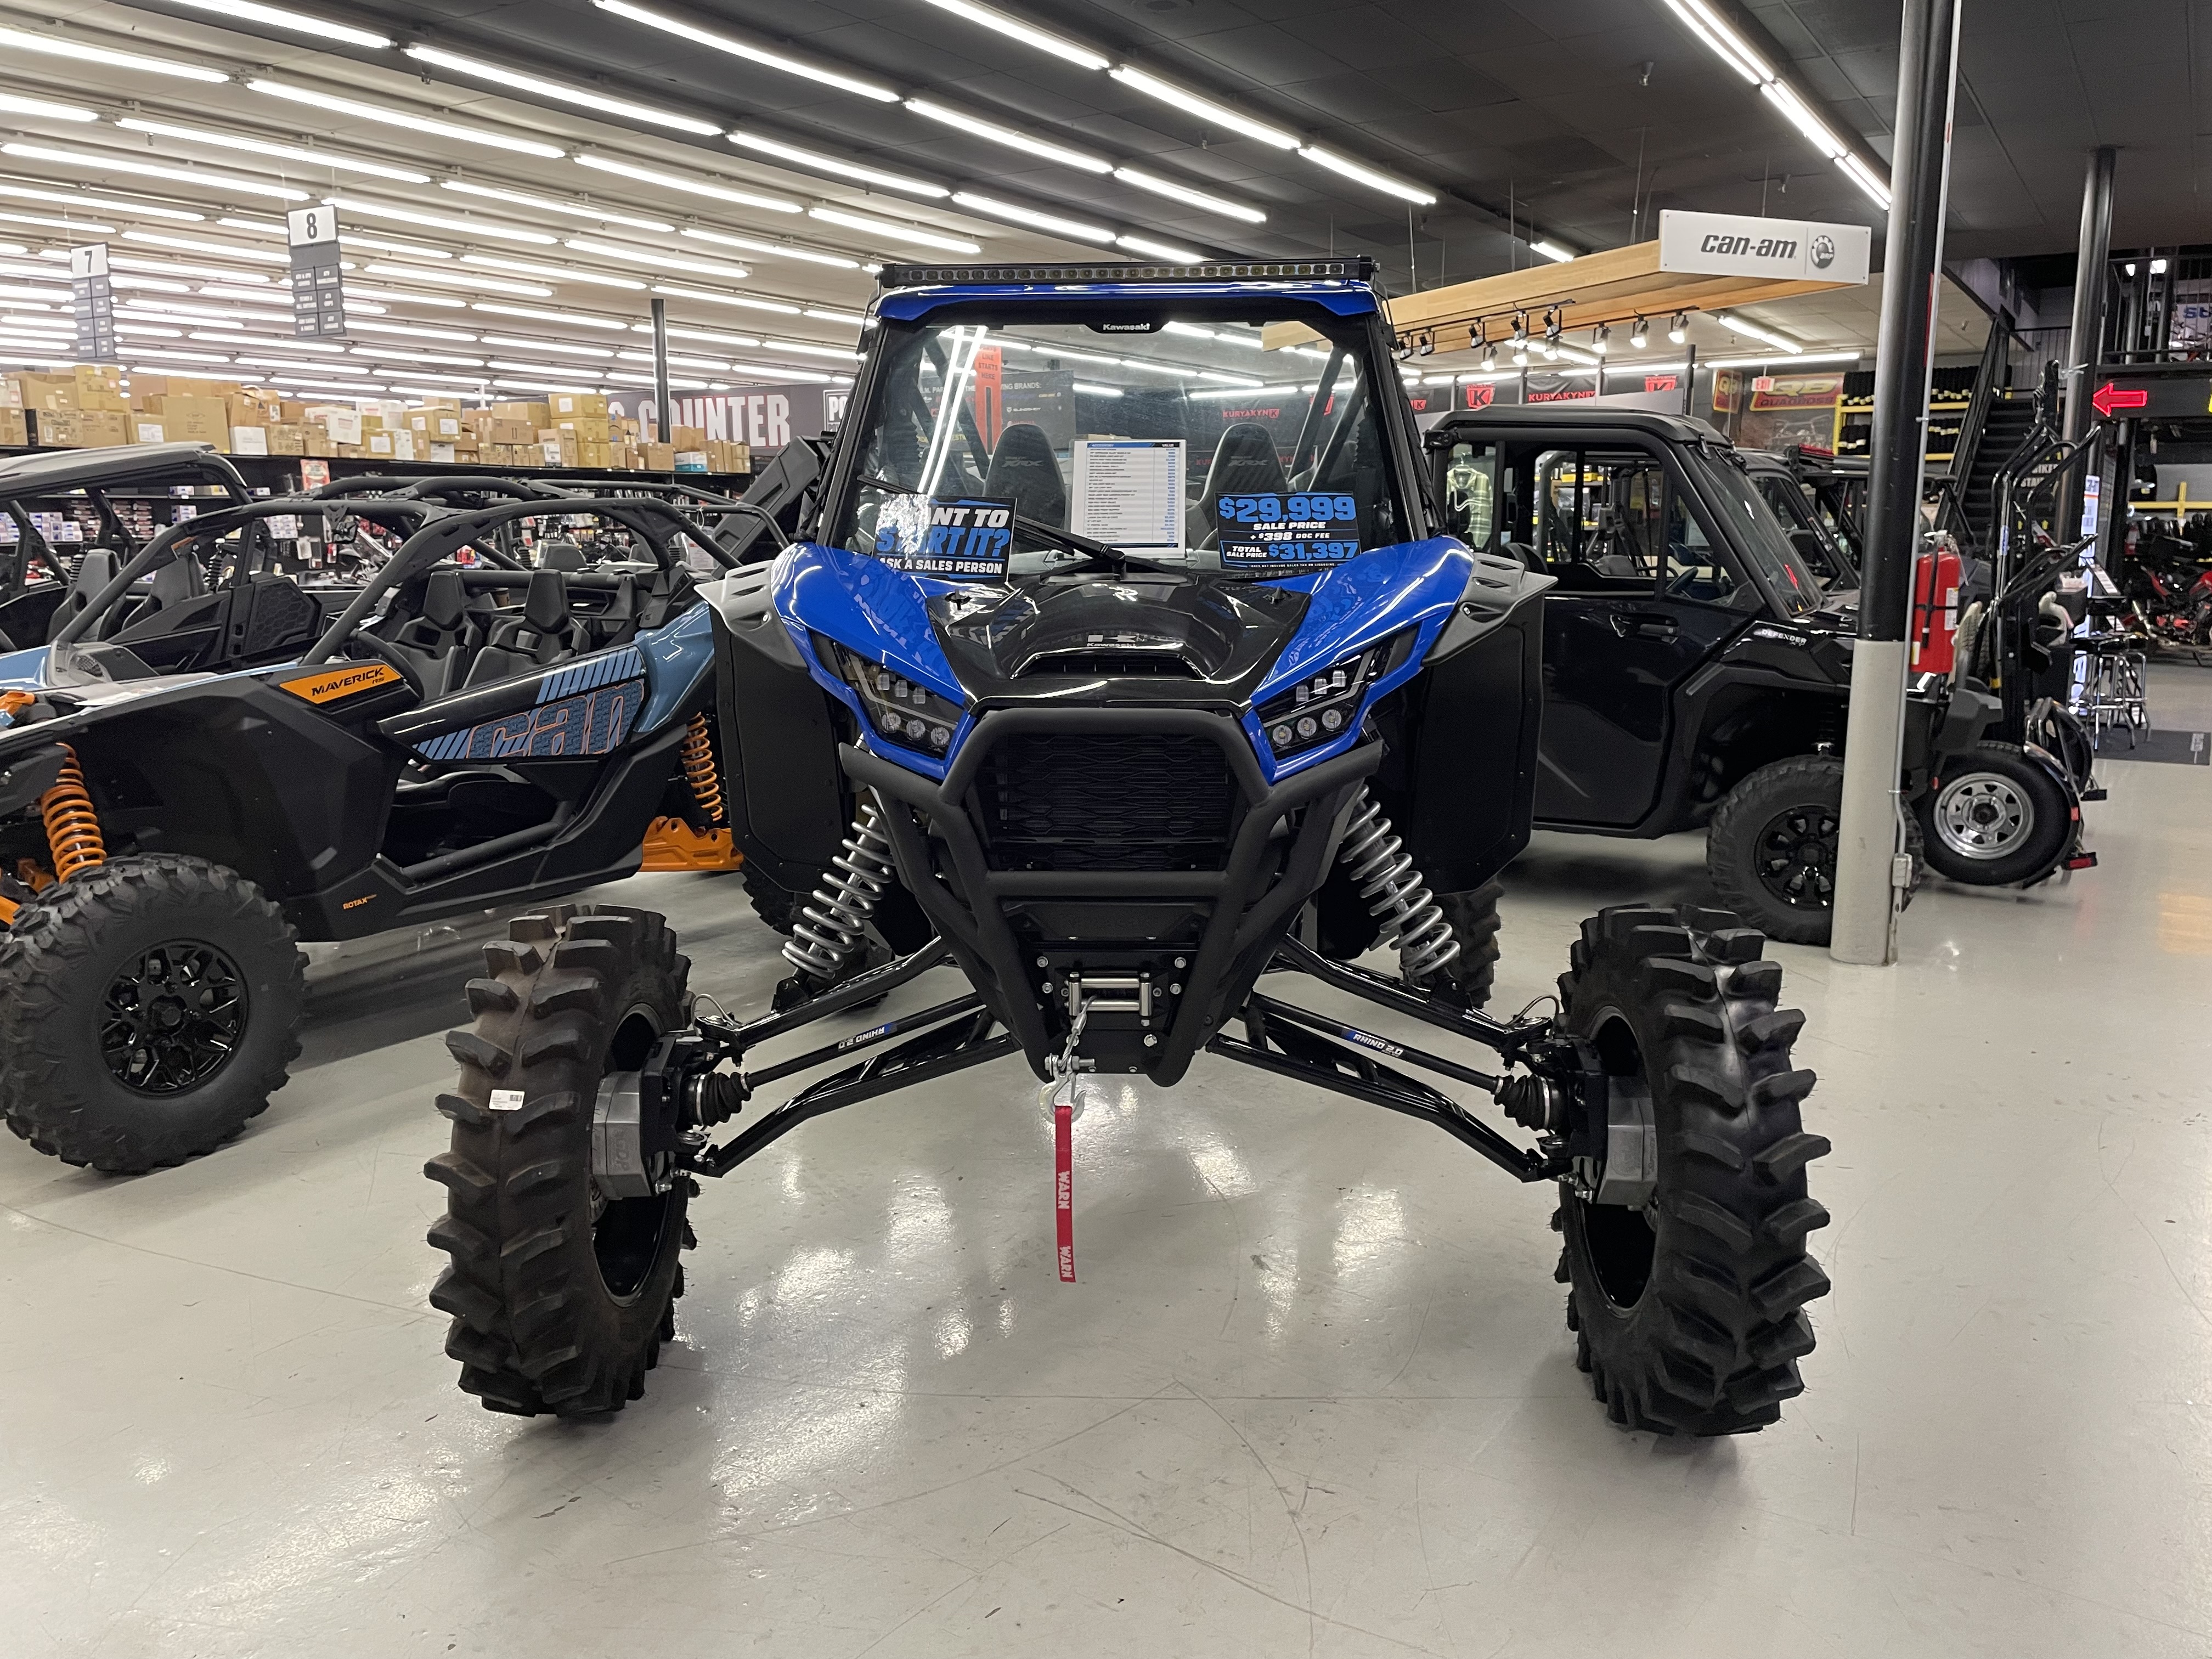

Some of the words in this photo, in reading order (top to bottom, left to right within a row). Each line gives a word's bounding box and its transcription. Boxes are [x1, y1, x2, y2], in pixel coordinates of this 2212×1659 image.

[306, 213, 317, 239] 8
[1701, 235, 1797, 259] can-am
[84, 250, 92, 273] 7
[1223, 409, 1268, 418] KURYAKYN
[974, 509, 1010, 528] TO
[1218, 496, 1357, 522] $29,999
[1253, 522, 1286, 531] SALE
[1258, 532, 1293, 541] $398
[964, 527, 1011, 557] IT?
[1268, 542, 1358, 560] $31,397
[904, 560, 912, 569] A
[916, 560, 953, 572] SALES
[956, 561, 1002, 574] PERSON
[312, 667, 384, 696] MAVERICK
[343, 897, 368, 910] ROTAX
[856, 1026, 885, 1043] RHINO
[1353, 1033, 1386, 1049] RHINO
[1385, 1044, 1404, 1056] 2.0
[1058, 1171, 1070, 1209] WARN
[1059, 1246, 1073, 1278] WARN
